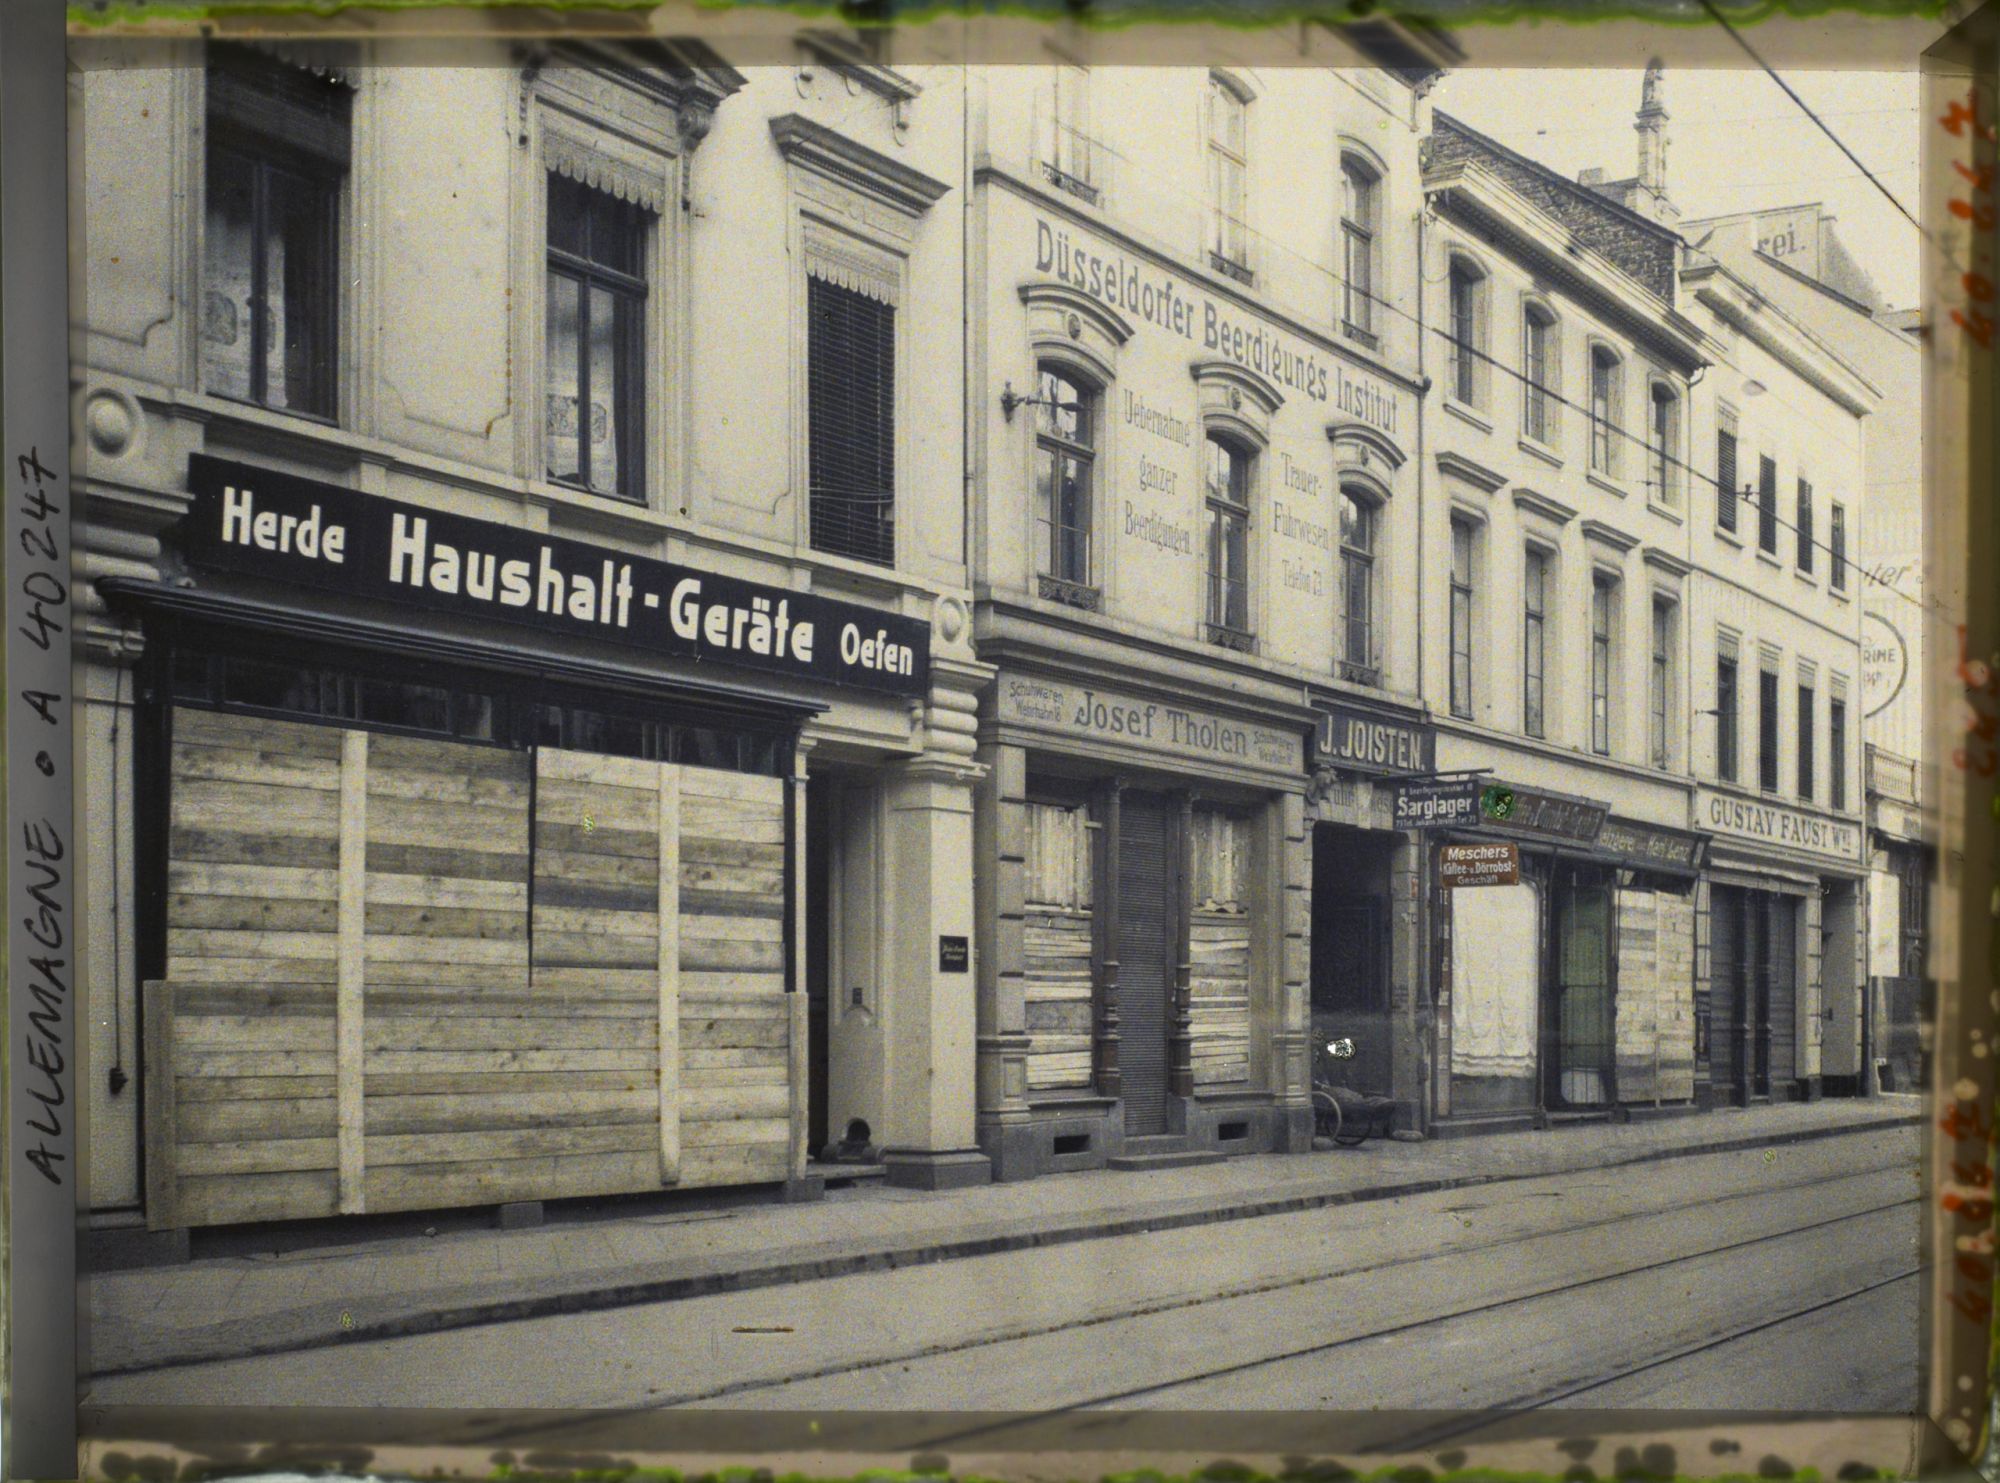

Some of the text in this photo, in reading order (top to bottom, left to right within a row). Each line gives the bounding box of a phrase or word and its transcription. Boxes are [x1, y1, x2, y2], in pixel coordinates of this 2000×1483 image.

[1035, 219, 1399, 434] Düsseldorfer Beerdigungs Institut
[1123, 389, 1191, 448] Uebernahme
[1139, 453, 1178, 496] ganzer
[221, 486, 346, 564] Herde
[389, 512, 633, 628] Haushalt
[670, 578, 814, 662] Geräte
[840, 623, 913, 676] Oefen
[21, 690, 62, 725] A
[1074, 691, 1249, 758] Josef Tholen
[1320, 715, 1426, 771] J. JOISTEN.
[1396, 794, 1473, 819] Sarglager
[1781, 814, 1829, 848] FAUST
[1447, 846, 1509, 861] Meschers
[1457, 874, 1499, 885] Geschäft
[24, 817, 66, 1186] ALLEMAGNE
